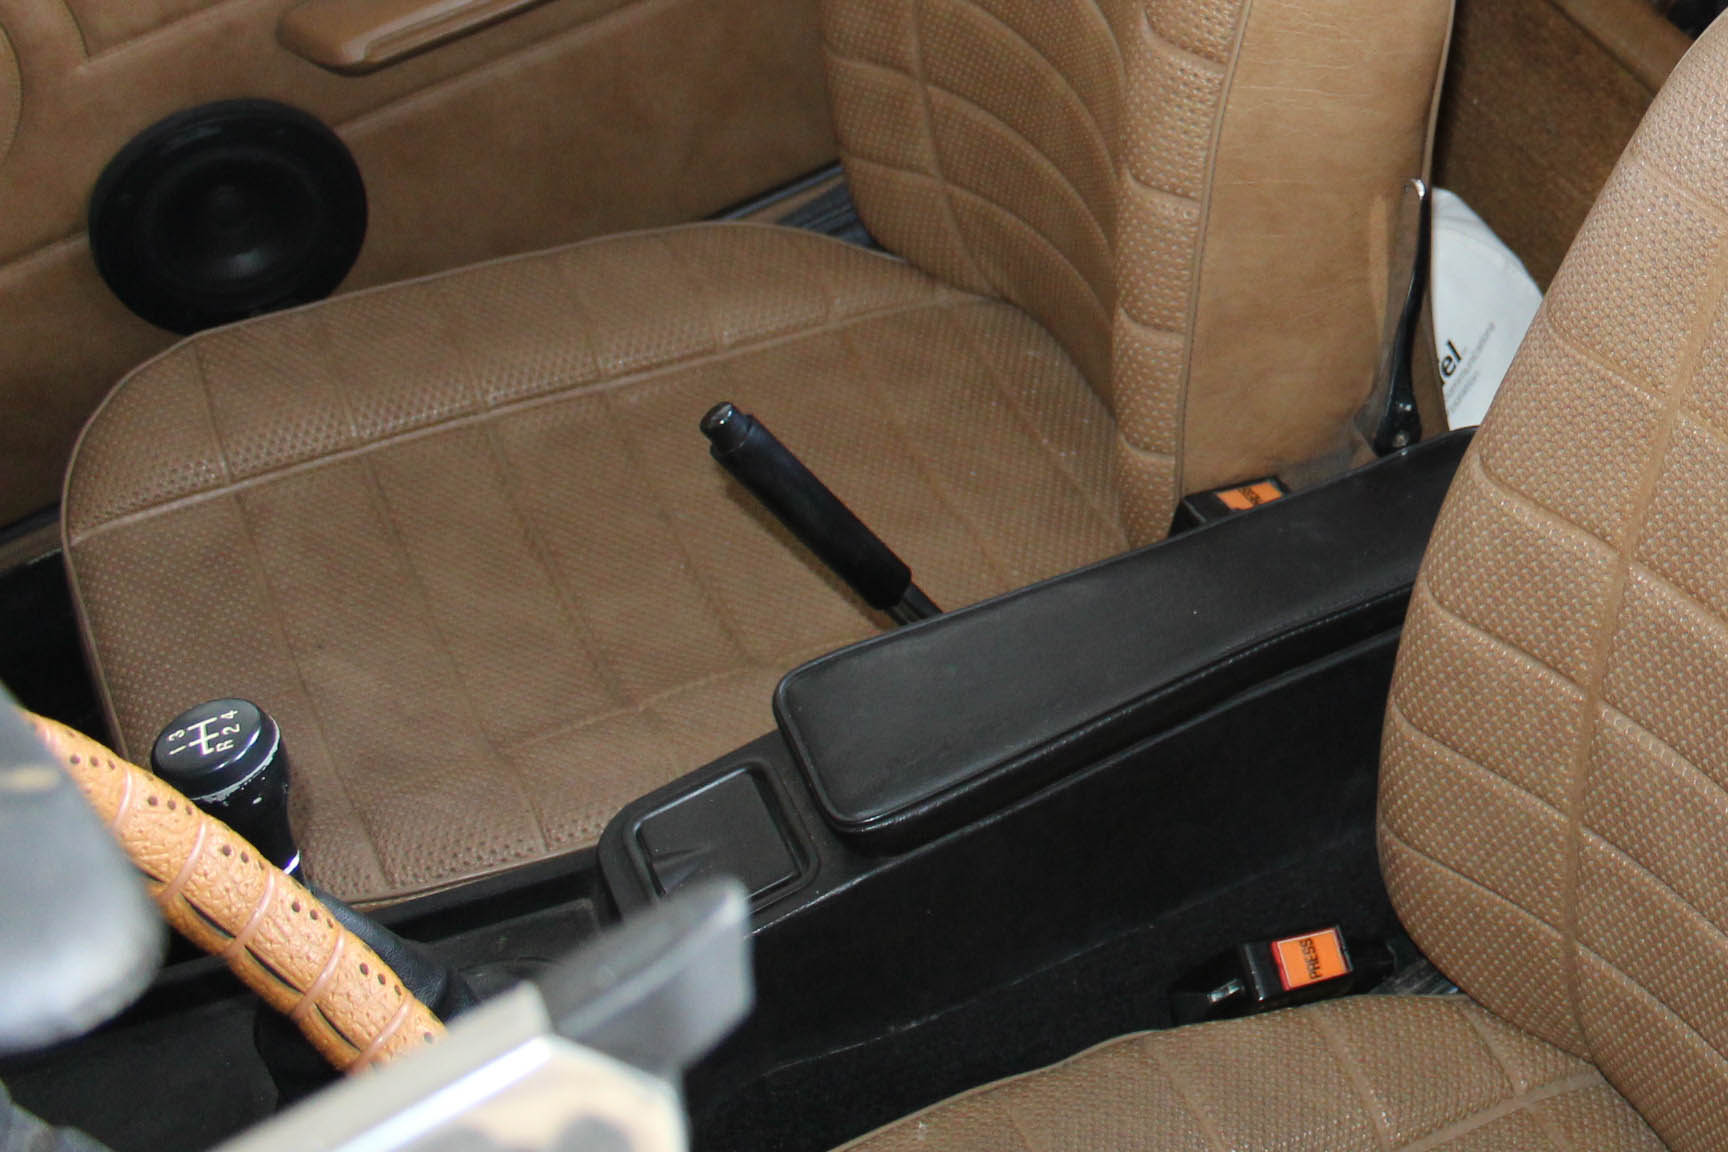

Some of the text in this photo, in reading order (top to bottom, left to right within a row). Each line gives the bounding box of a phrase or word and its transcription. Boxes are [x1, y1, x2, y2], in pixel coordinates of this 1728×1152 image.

[219, 709, 238, 720] 4
[167, 729, 186, 741] 3
[222, 723, 240, 735] 2
[215, 739, 234, 752] R
[1299, 937, 1323, 980] PRESS
